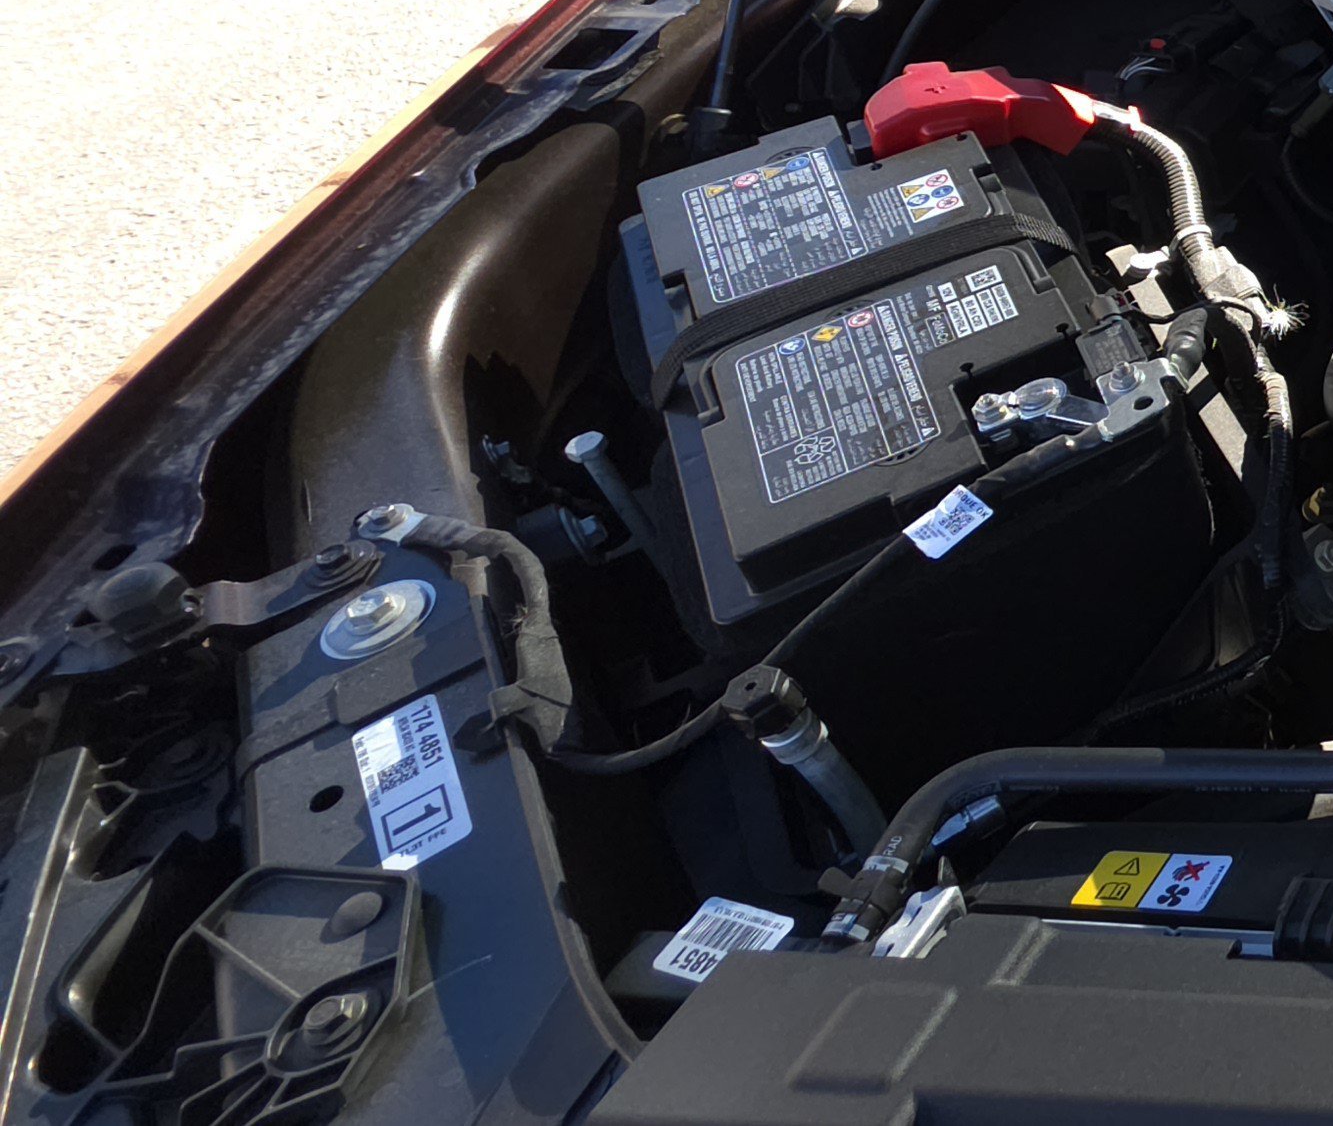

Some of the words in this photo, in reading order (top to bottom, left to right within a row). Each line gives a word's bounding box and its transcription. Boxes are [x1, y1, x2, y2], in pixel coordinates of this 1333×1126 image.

[974, 506, 989, 518] OK
[411, 700, 434, 734] 174
[418, 735, 445, 769] 4851
[669, 945, 718, 975] 4851
